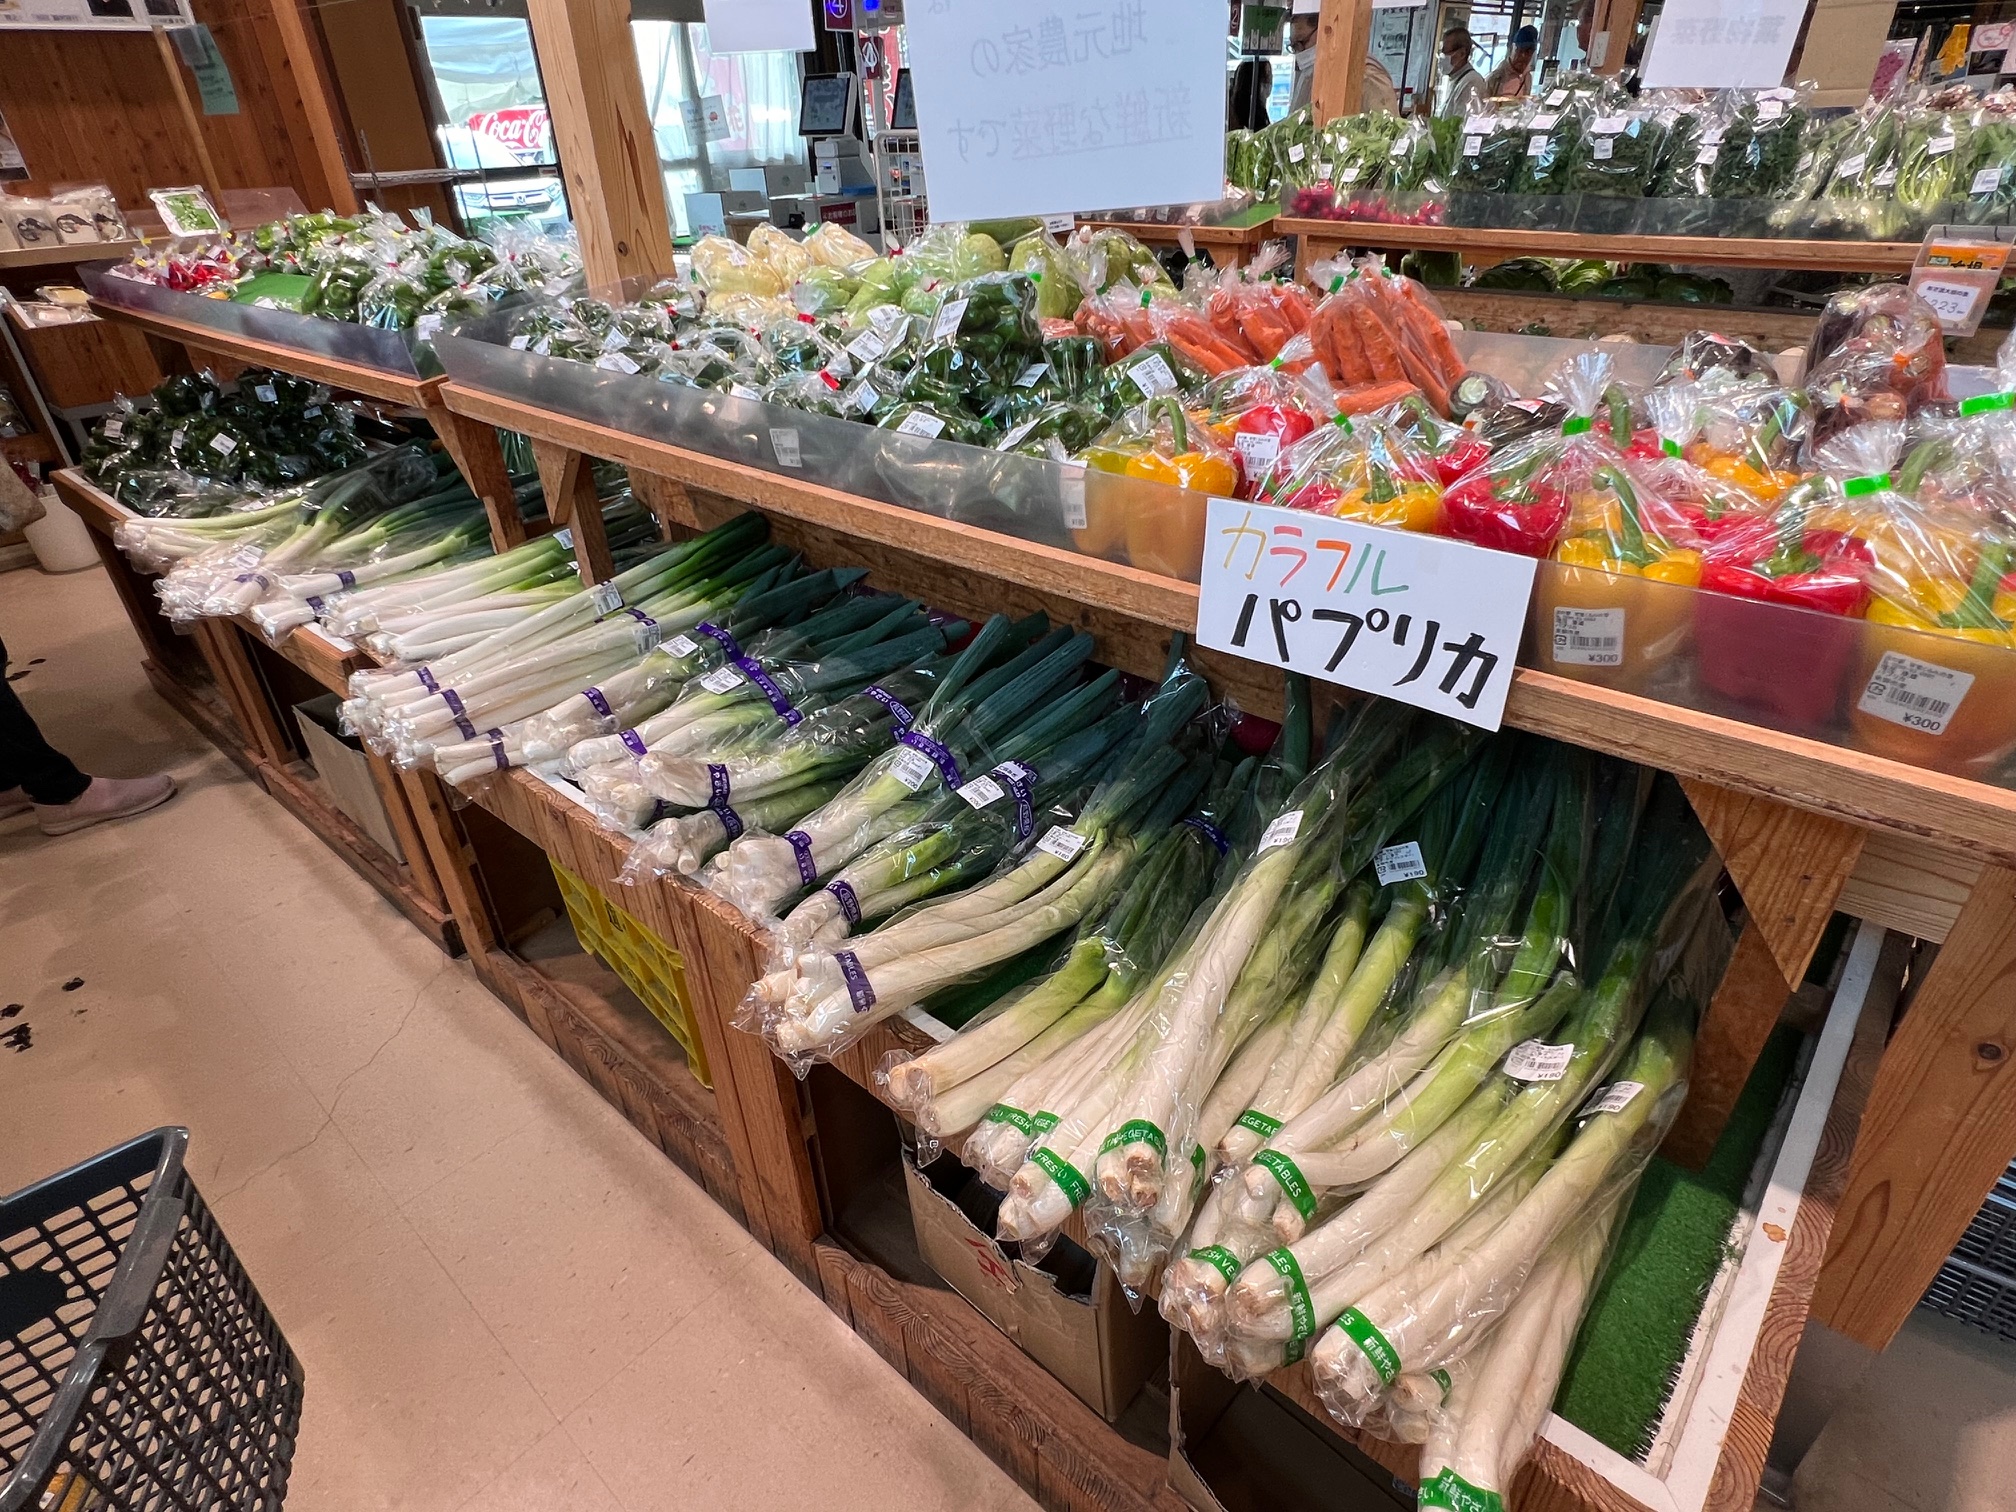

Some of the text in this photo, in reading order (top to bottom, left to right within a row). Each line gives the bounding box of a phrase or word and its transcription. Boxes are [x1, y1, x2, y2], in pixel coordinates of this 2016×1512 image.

[1222, 510, 1410, 596] カラフル
[1231, 593, 1499, 710] パプリカ
[1588, 653, 1619, 663] ¥300
[1903, 712, 1942, 732] ¥300
